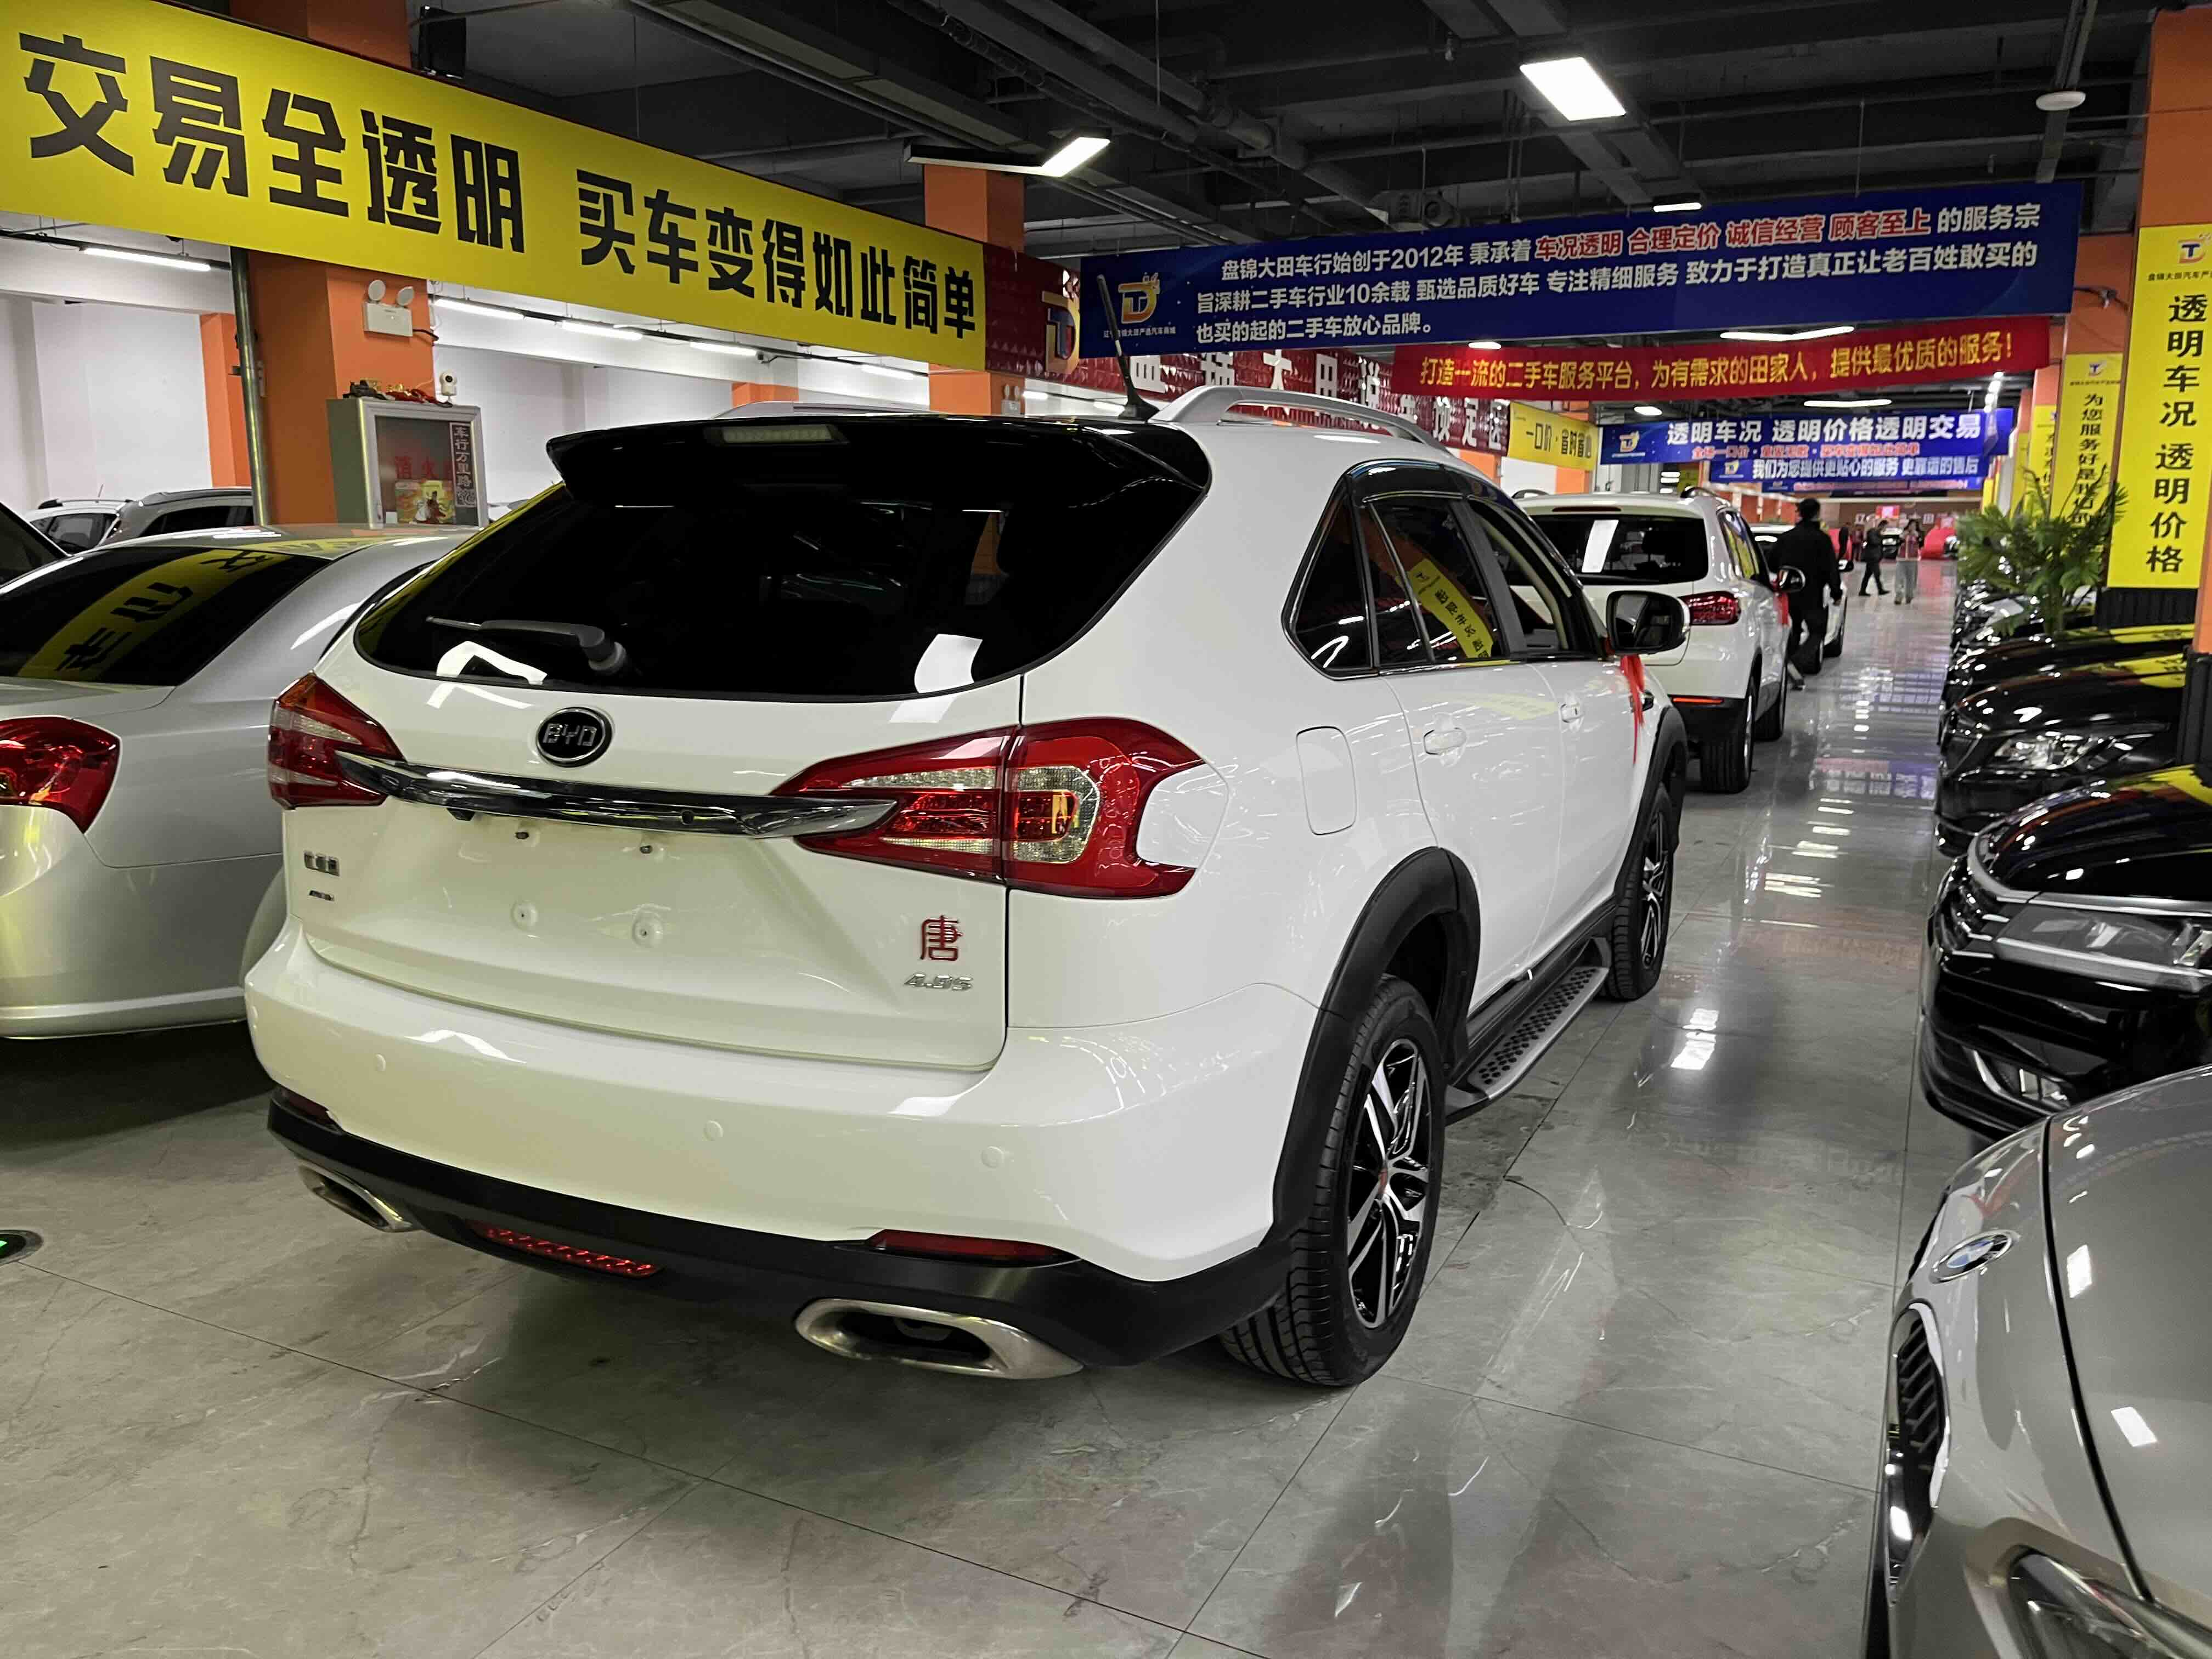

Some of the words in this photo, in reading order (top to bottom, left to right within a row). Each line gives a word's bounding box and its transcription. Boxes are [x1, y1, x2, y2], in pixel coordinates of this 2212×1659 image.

[19, 32, 524, 253] 交易全透明
[577, 168, 977, 338] 买车变得如此简单
[1198, 280, 1409, 314] 旨深耕二手车行业10余载
[1417, 272, 1539, 302] 甄选品质好车
[1547, 262, 1679, 294] 专注精细服务
[1686, 241, 2038, 284] 致力于打造真正让老百姓敢买的
[1221, 245, 1464, 280] 盘锦大田车行始创于2012年
[1470, 238, 1531, 266] 秉承着
[1534, 230, 1623, 262] 车况透明
[1628, 222, 1720, 256] 合理定价
[1726, 214, 1825, 247] 诚信经营
[1828, 207, 1932, 241] 顾客至上
[1937, 203, 2041, 233] 的服务宗
[1197, 312, 1431, 343] 也买的起的二手车放心品牌。
[2159, 294, 2208, 427] 透明车况
[1667, 420, 1762, 446] 透明车况
[1773, 413, 1981, 443] 透明价格透明交易
[2146, 443, 2194, 573] 透明价格
[543, 723, 597, 746] BYD
[920, 914, 963, 961] 唐
